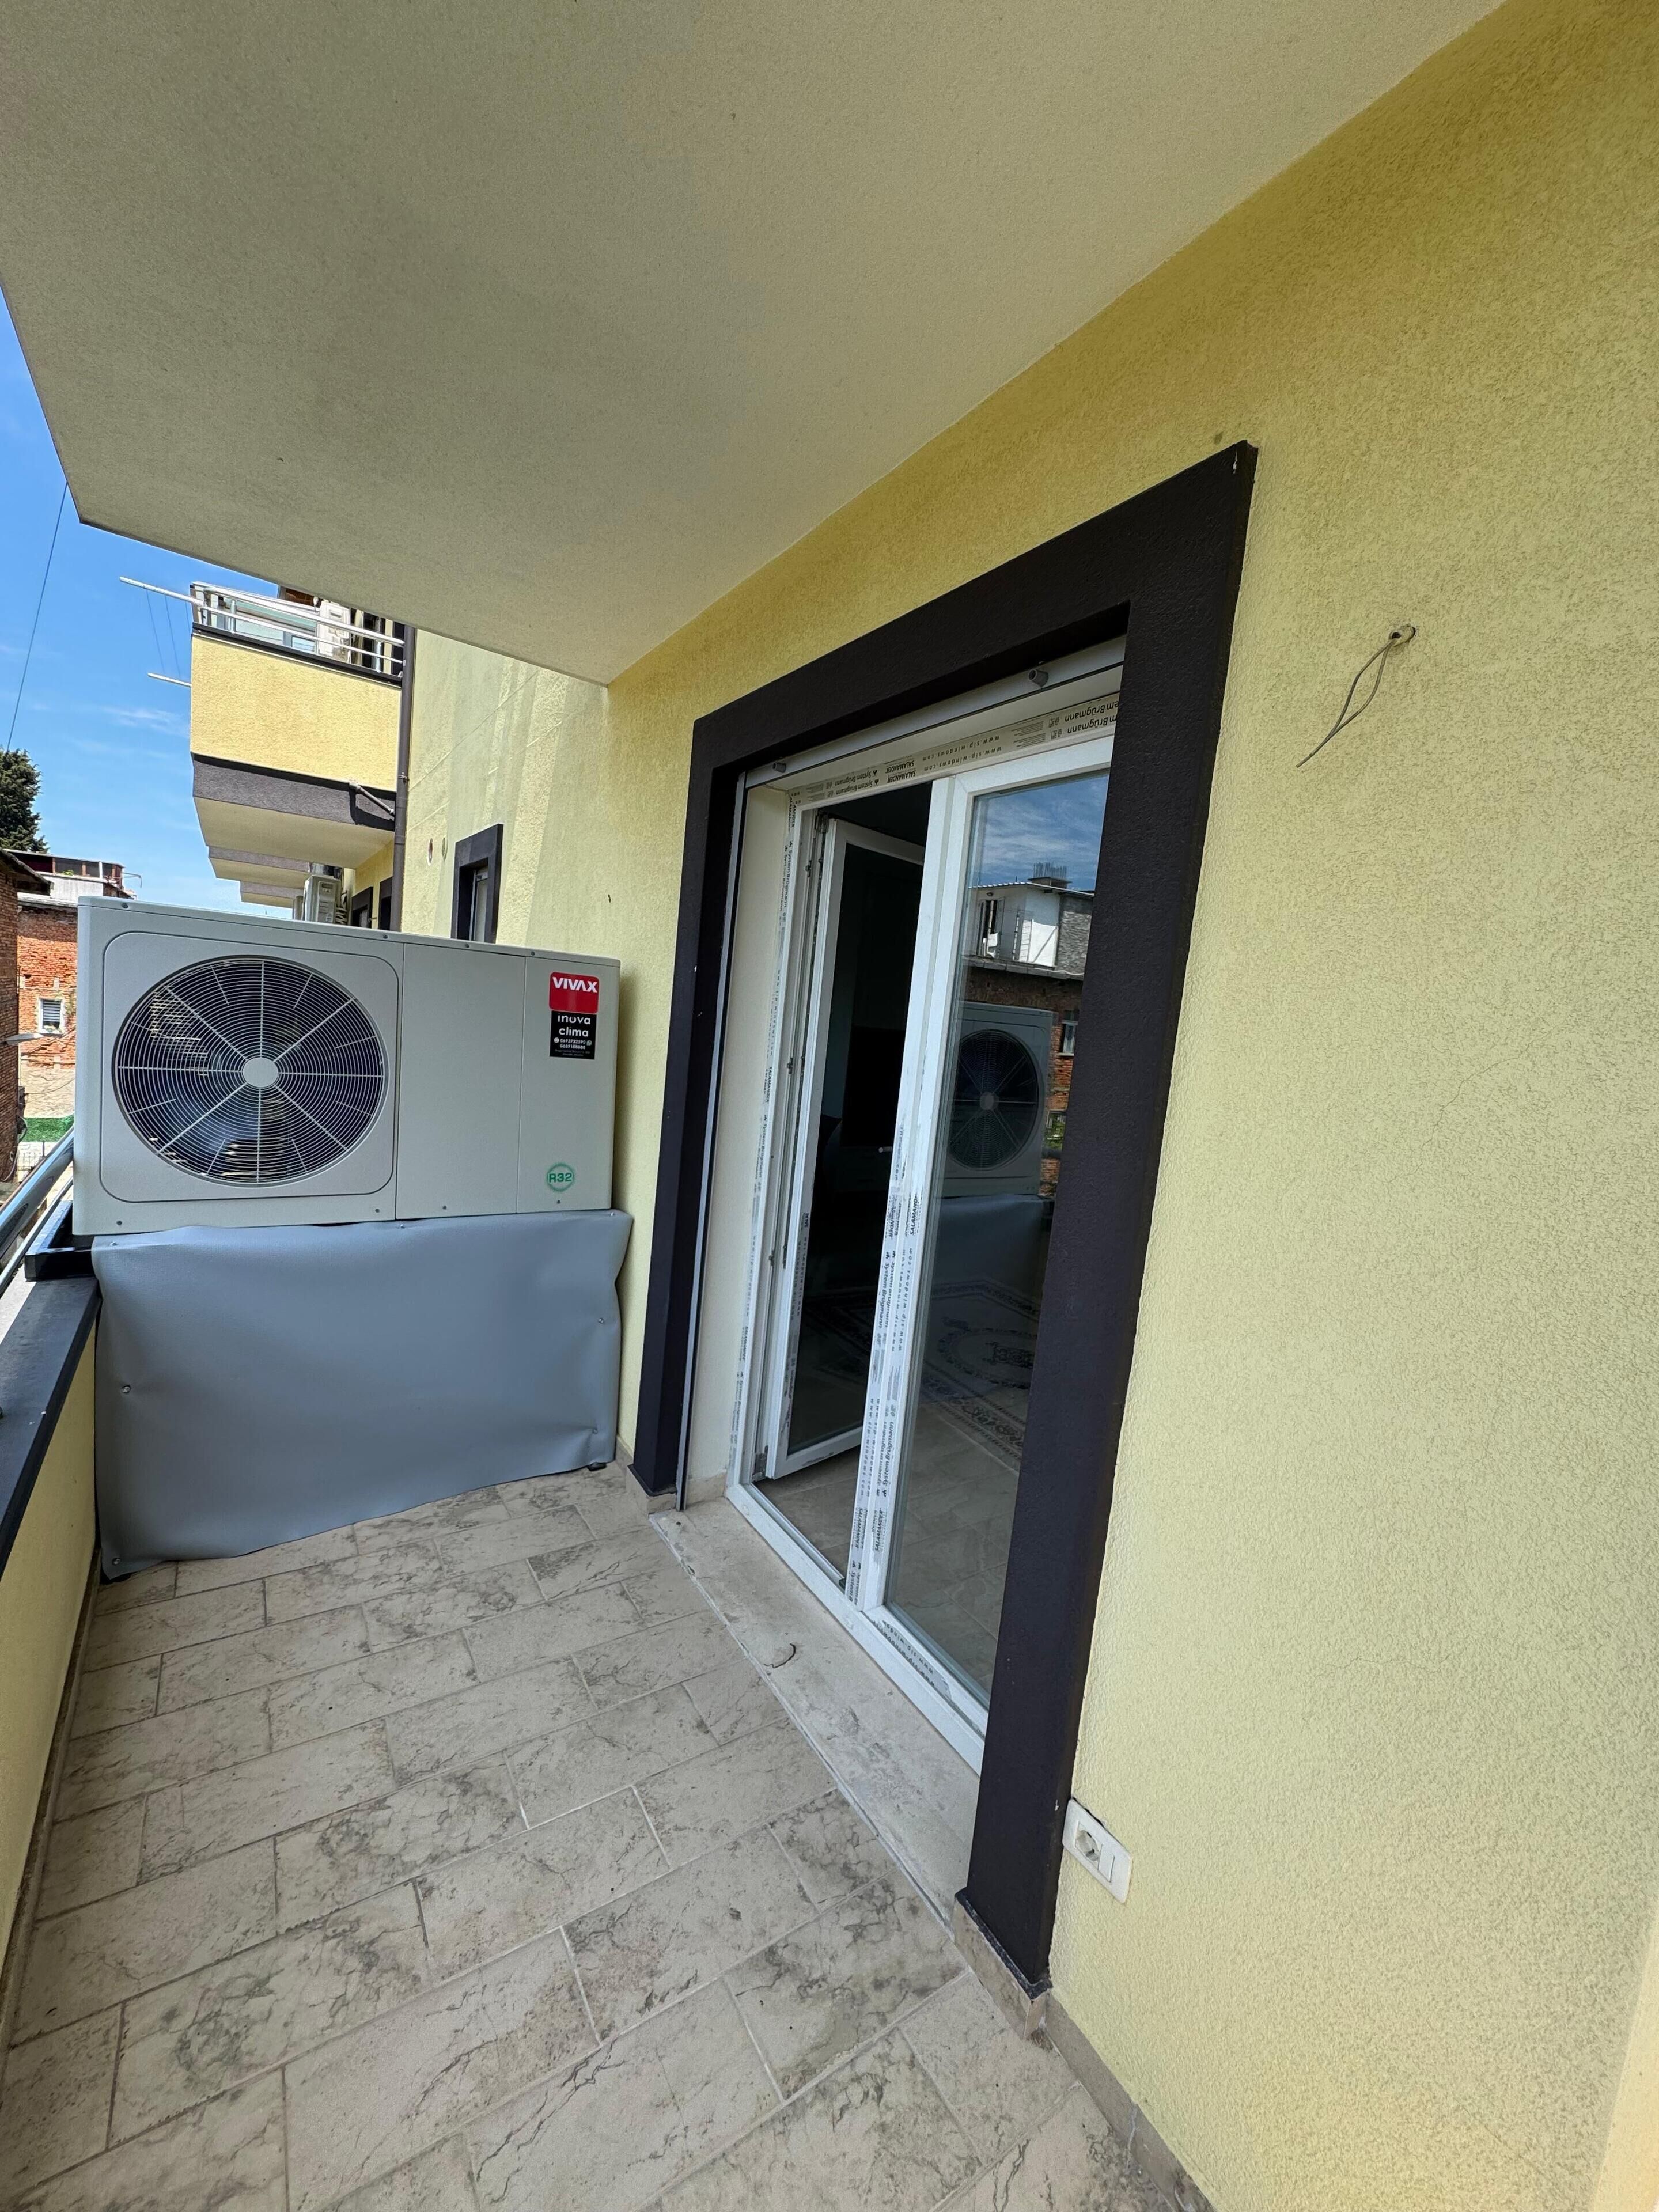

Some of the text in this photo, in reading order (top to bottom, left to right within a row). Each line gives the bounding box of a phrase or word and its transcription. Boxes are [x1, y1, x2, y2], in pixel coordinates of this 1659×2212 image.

[1065, 705, 1105, 722] Brügmann
[1067, 717, 1108, 734] Brügmann
[922, 735, 999, 762] www.sip-windows.com
[924, 747, 1002, 772] www.sip-windows.com
[856, 771, 872, 781] System
[857, 781, 873, 790] System
[552, 977, 597, 993] VIVAX
[558, 1013, 590, 1025] inova
[559, 1027, 589, 1037] clima
[549, 1173, 572, 1183] R32
[898, 1248, 913, 1351] www.sip-windows.com
